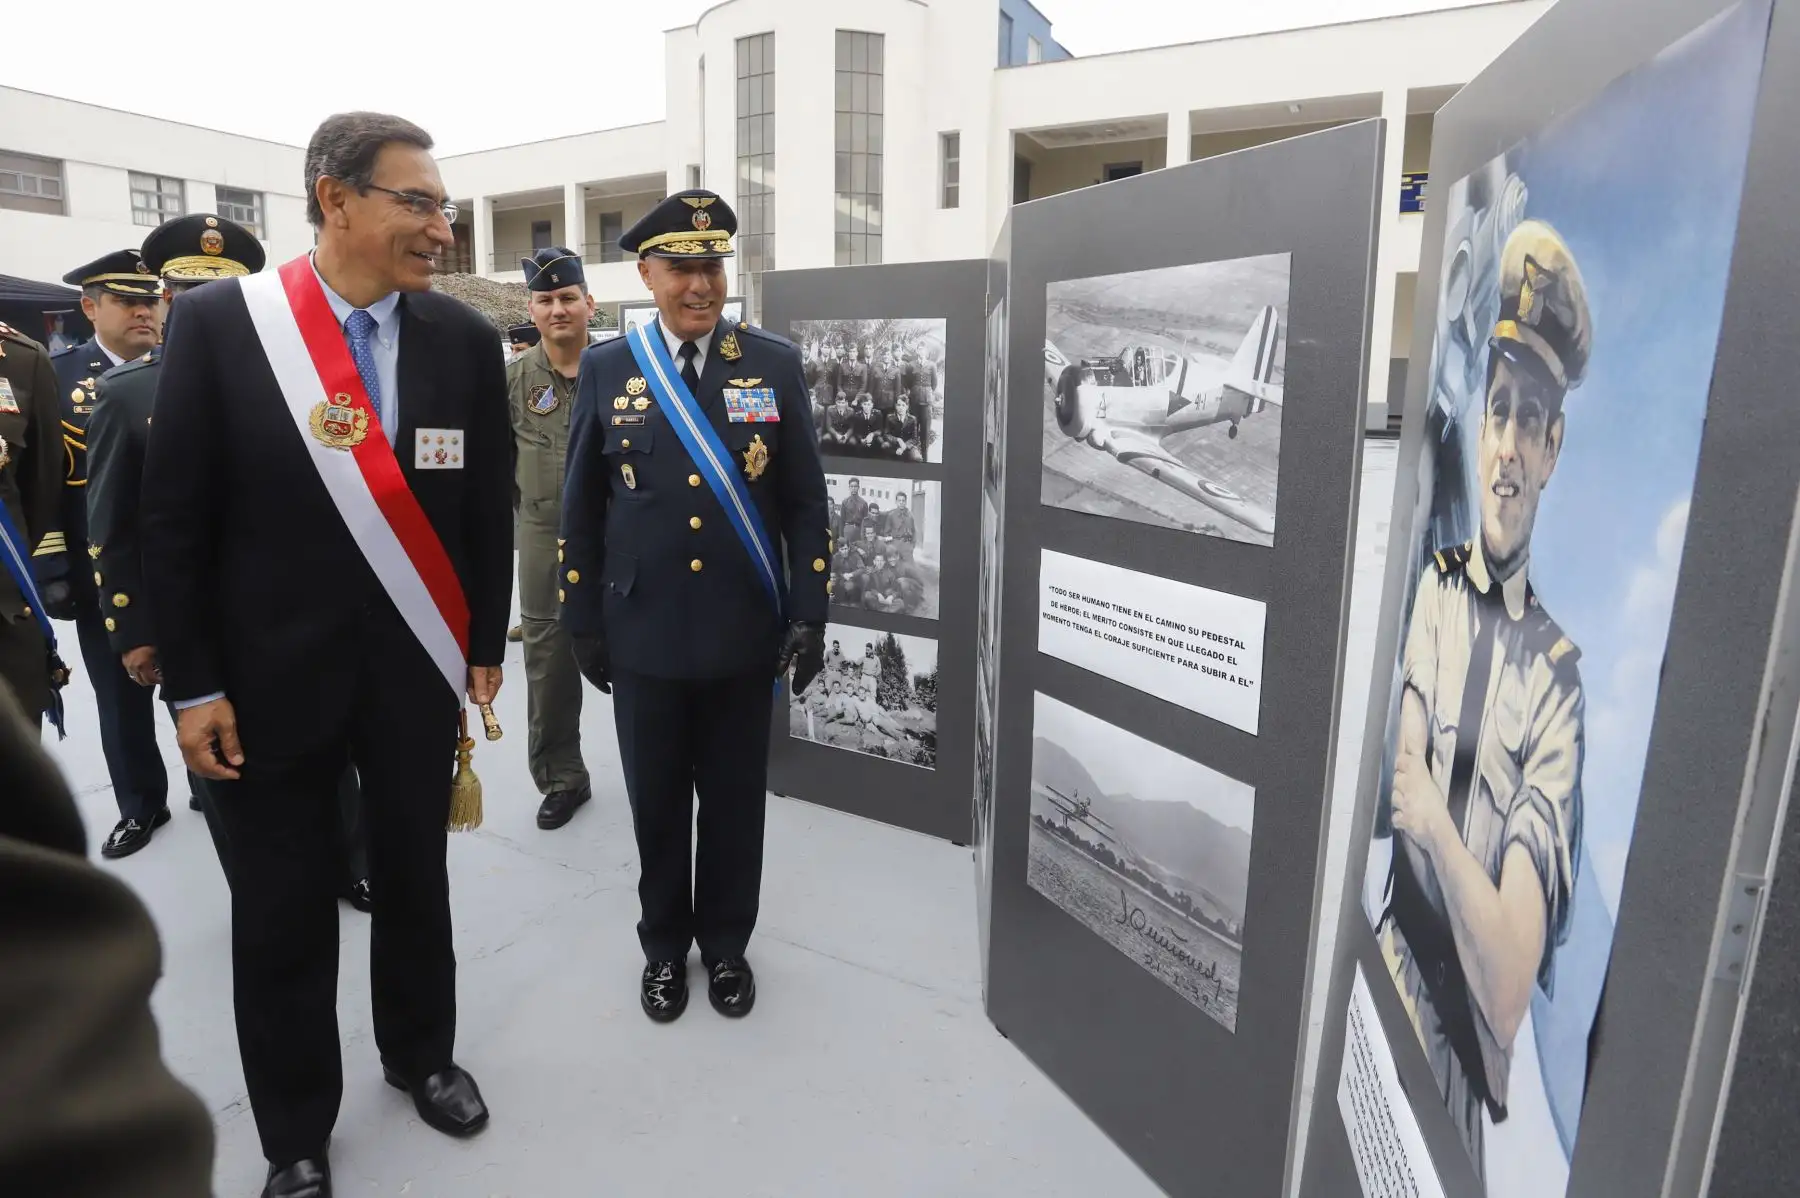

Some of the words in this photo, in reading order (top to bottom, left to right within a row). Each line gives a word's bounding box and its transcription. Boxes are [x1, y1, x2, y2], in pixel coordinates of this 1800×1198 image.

[1042, 611, 1072, 627] MOMENTO
[1071, 621, 1093, 635] TENGA
[1093, 629, 1103, 638] EL
[1103, 632, 1131, 647] CORAJE
[1131, 641, 1176, 663] SUFICIENTE
[1177, 657, 1200, 670] PARA
[1200, 664, 1228, 680] SUBIR
[1228, 674, 1235, 683] A
[1050, 600, 1059, 608] DE
[1059, 602, 1082, 617] HEROE;
[1082, 610, 1091, 619] EL
[1091, 612, 1118, 627] MERITO
[1118, 621, 1154, 639] CONSISTE
[1155, 633, 1166, 643] EN
[1167, 637, 1185, 648] QUE
[1185, 642, 1225, 661] LLEGADO
[1226, 655, 1238, 666] EL
[1067, 590, 1081, 600] SER
[1081, 595, 1111, 609] HUMANO
[1111, 603, 1133, 616] TIENE
[1133, 609, 1144, 619] EN
[1144, 613, 1154, 622] EL
[1155, 616, 1187, 632] CAMINO
[1187, 625, 1200, 636] SU
[1201, 629, 1246, 650] PEDESTAL
